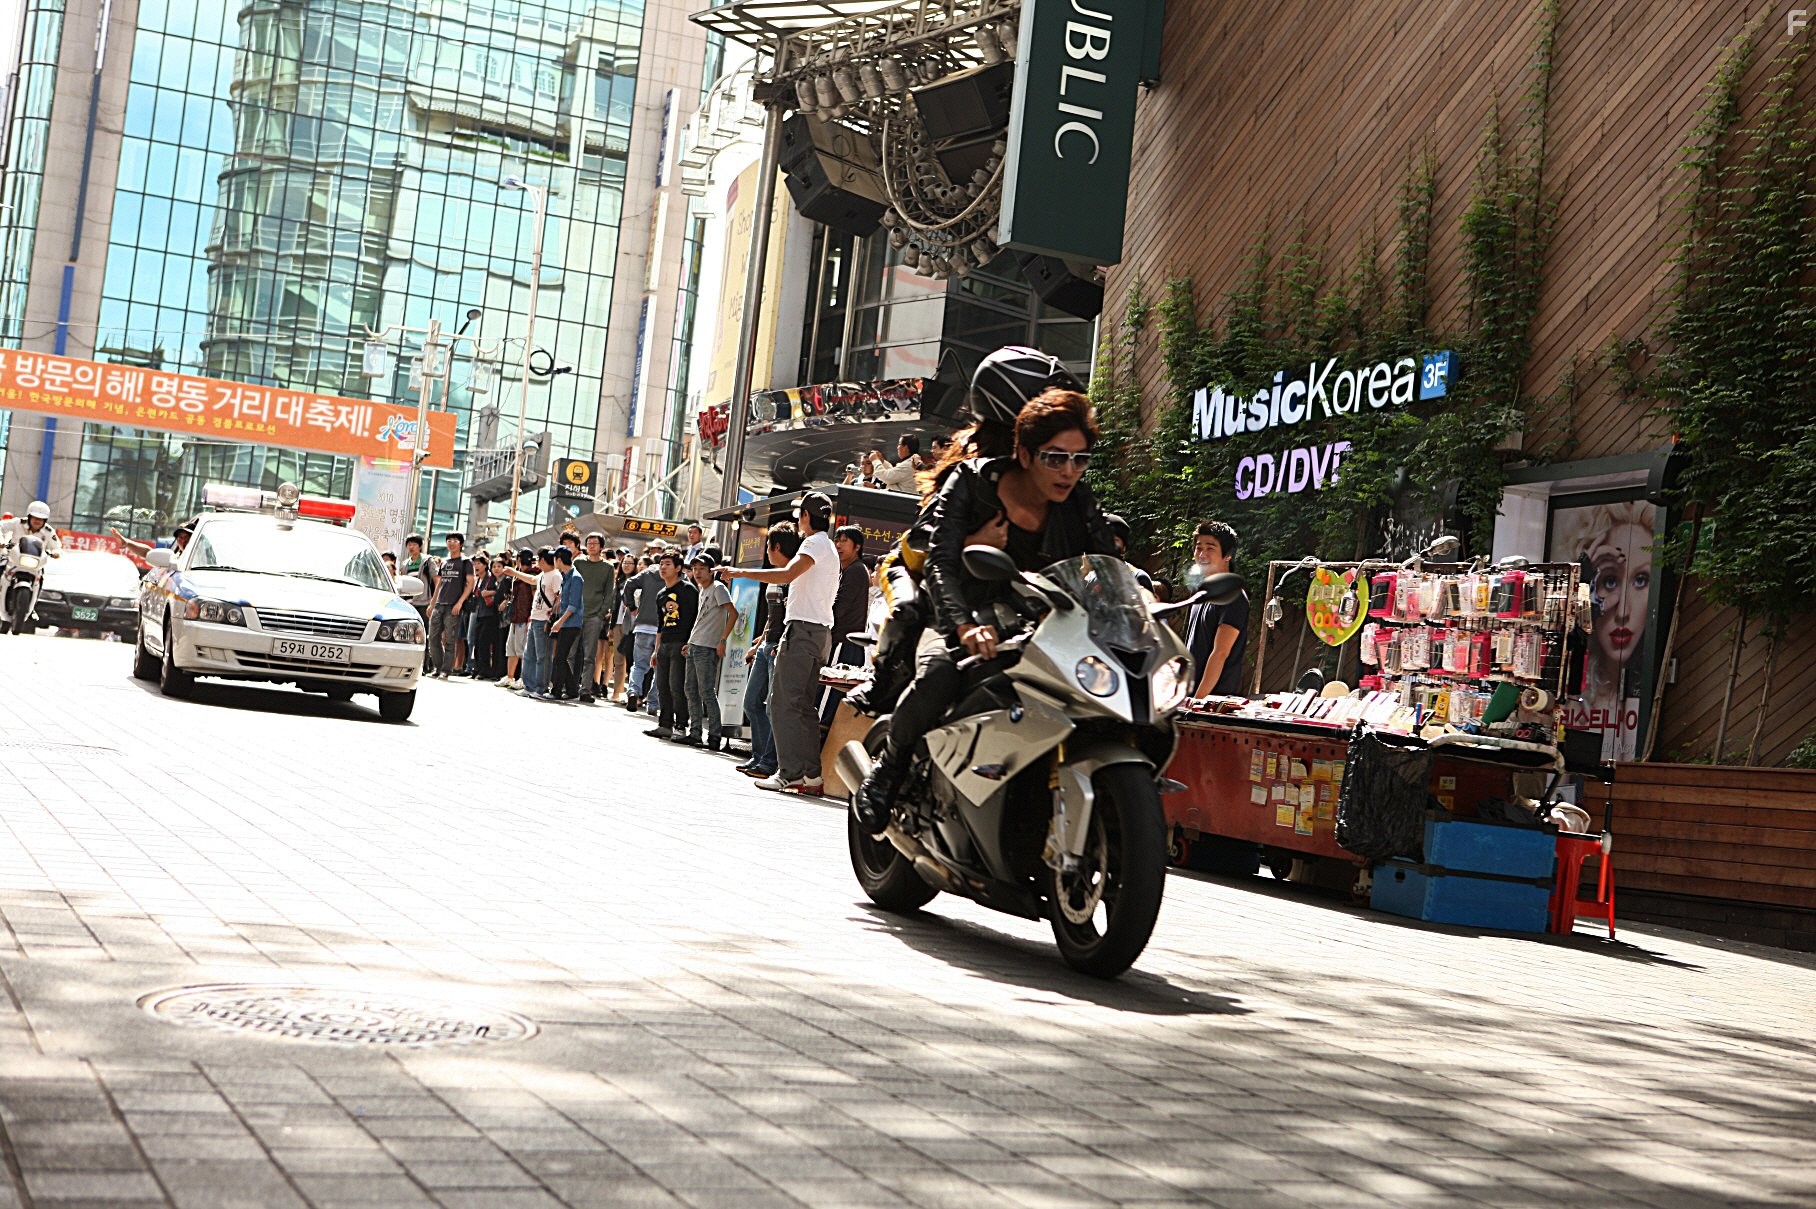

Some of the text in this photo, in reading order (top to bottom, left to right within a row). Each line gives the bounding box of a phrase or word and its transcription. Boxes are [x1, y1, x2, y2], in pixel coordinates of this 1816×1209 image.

[15, 355, 103, 398] 방문의
[105, 370, 145, 403] 해!
[150, 375, 209, 412] 명동
[212, 387, 271, 422] 거리
[1423, 361, 1447, 390] 3F
[280, 641, 344, 660] 59저 0252
